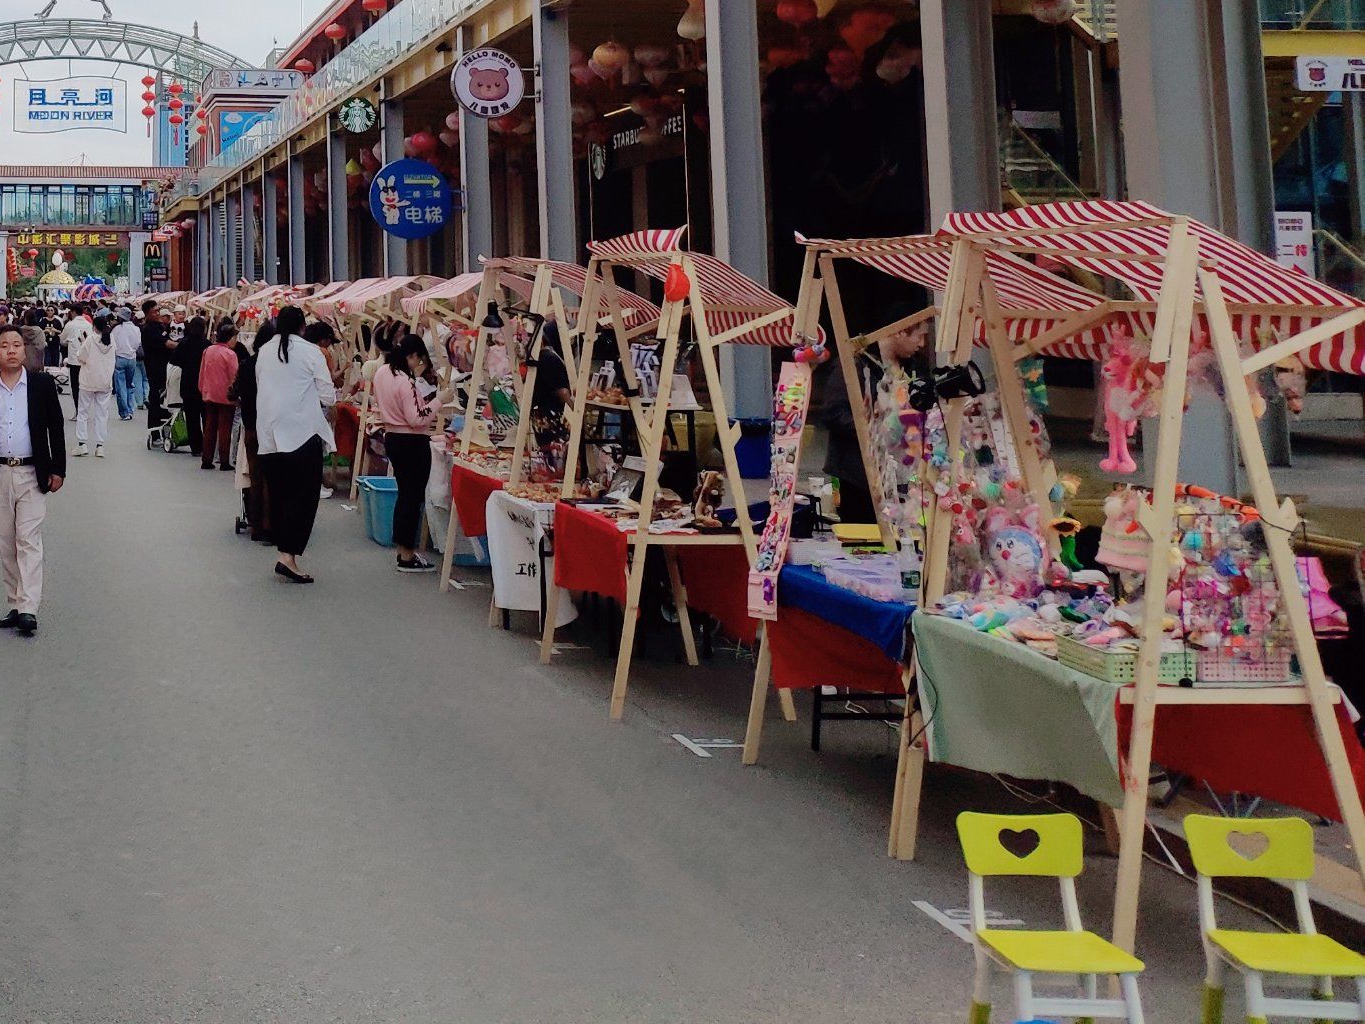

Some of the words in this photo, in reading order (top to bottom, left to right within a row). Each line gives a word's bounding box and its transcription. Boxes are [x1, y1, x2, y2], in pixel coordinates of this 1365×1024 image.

[461, 51, 489, 68] HELLO
[491, 51, 516, 69] MOMO
[28, 88, 114, 105] 月亮河
[28, 110, 70, 121] MOON
[73, 110, 114, 121] RIVER
[404, 205, 443, 224] 电梯
